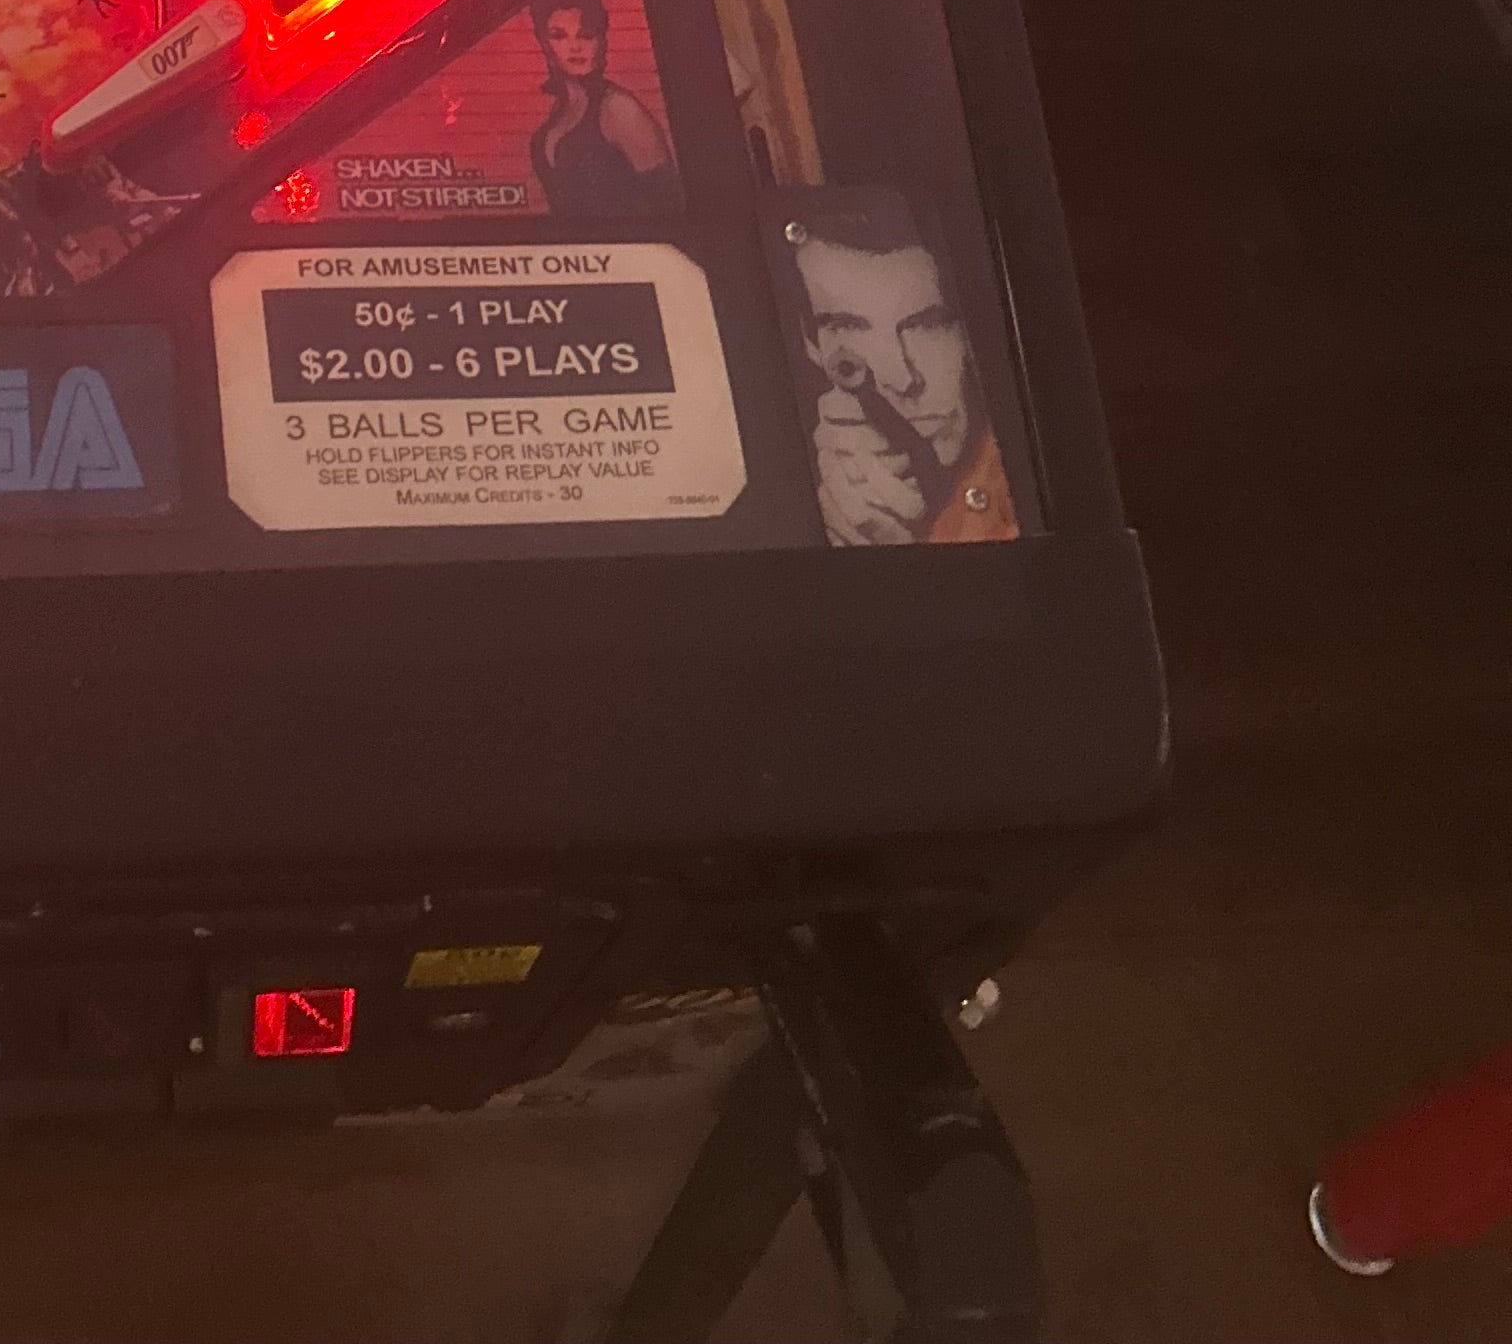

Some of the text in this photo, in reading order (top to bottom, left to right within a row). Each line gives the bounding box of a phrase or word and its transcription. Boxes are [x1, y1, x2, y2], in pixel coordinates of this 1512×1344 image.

[150, 26, 195, 76] 007
[339, 183, 529, 209] NOT STIRRED!
[299, 255, 613, 279] FOR AMUSEMENT ONLY
[354, 299, 569, 332] 50¢ 1 PLAY
[299, 343, 640, 384] $2.00 6 PLAYS
[286, 406, 673, 440] 3 BALLS PER GAME
[305, 439, 661, 466] HOLD FLIPPERS FOR INSTANT INFO
[318, 460, 656, 486] SEE DISPLAY FOR REPLAY VALUE
[559, 485, 583, 502] 30
